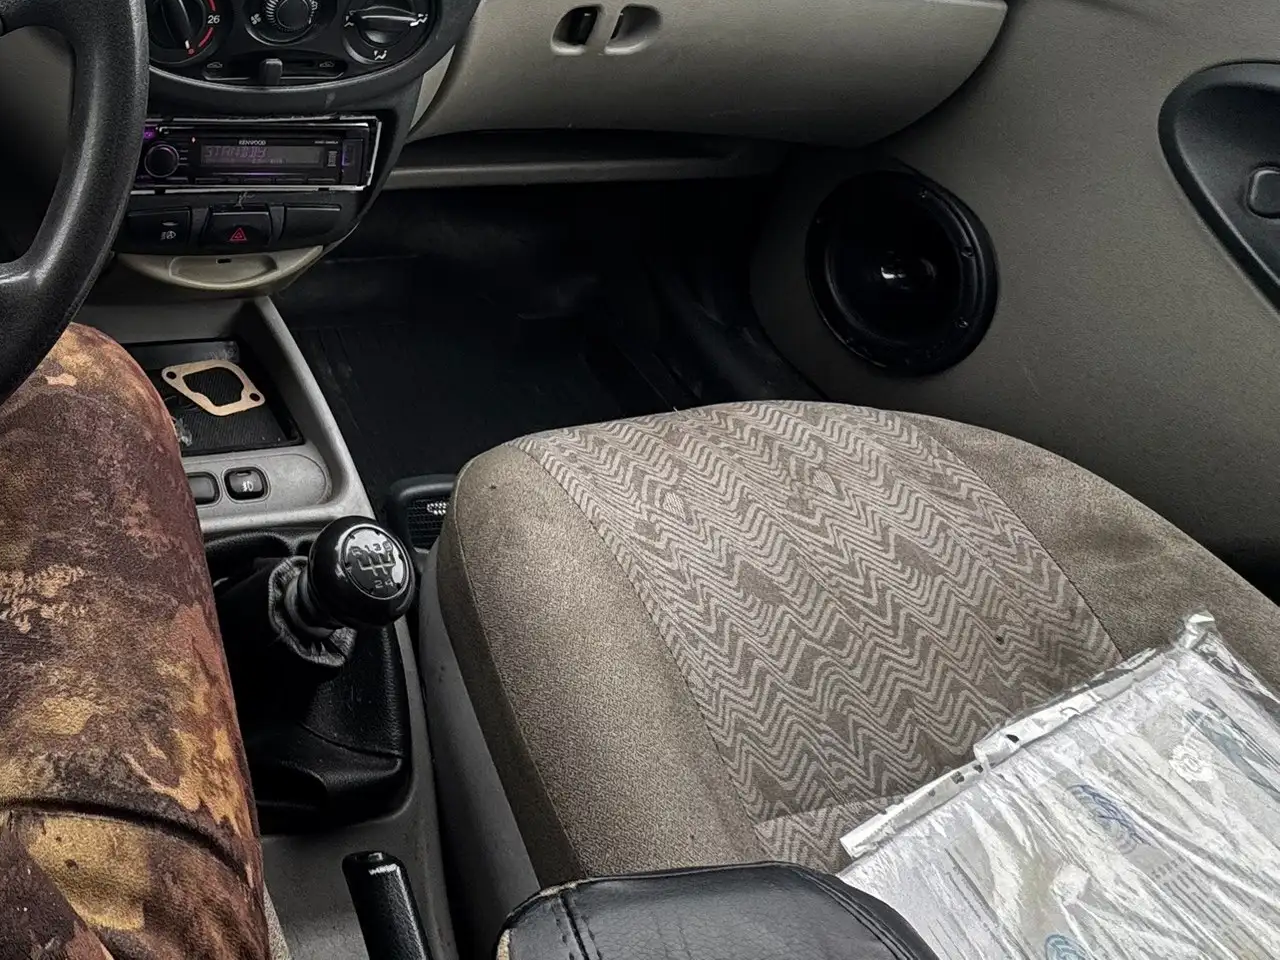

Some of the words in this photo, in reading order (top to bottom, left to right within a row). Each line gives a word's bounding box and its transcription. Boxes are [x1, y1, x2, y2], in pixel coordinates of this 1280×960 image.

[207, 14, 221, 24] 26
[374, 579, 384, 589] 2
[384, 578, 394, 587] 4
